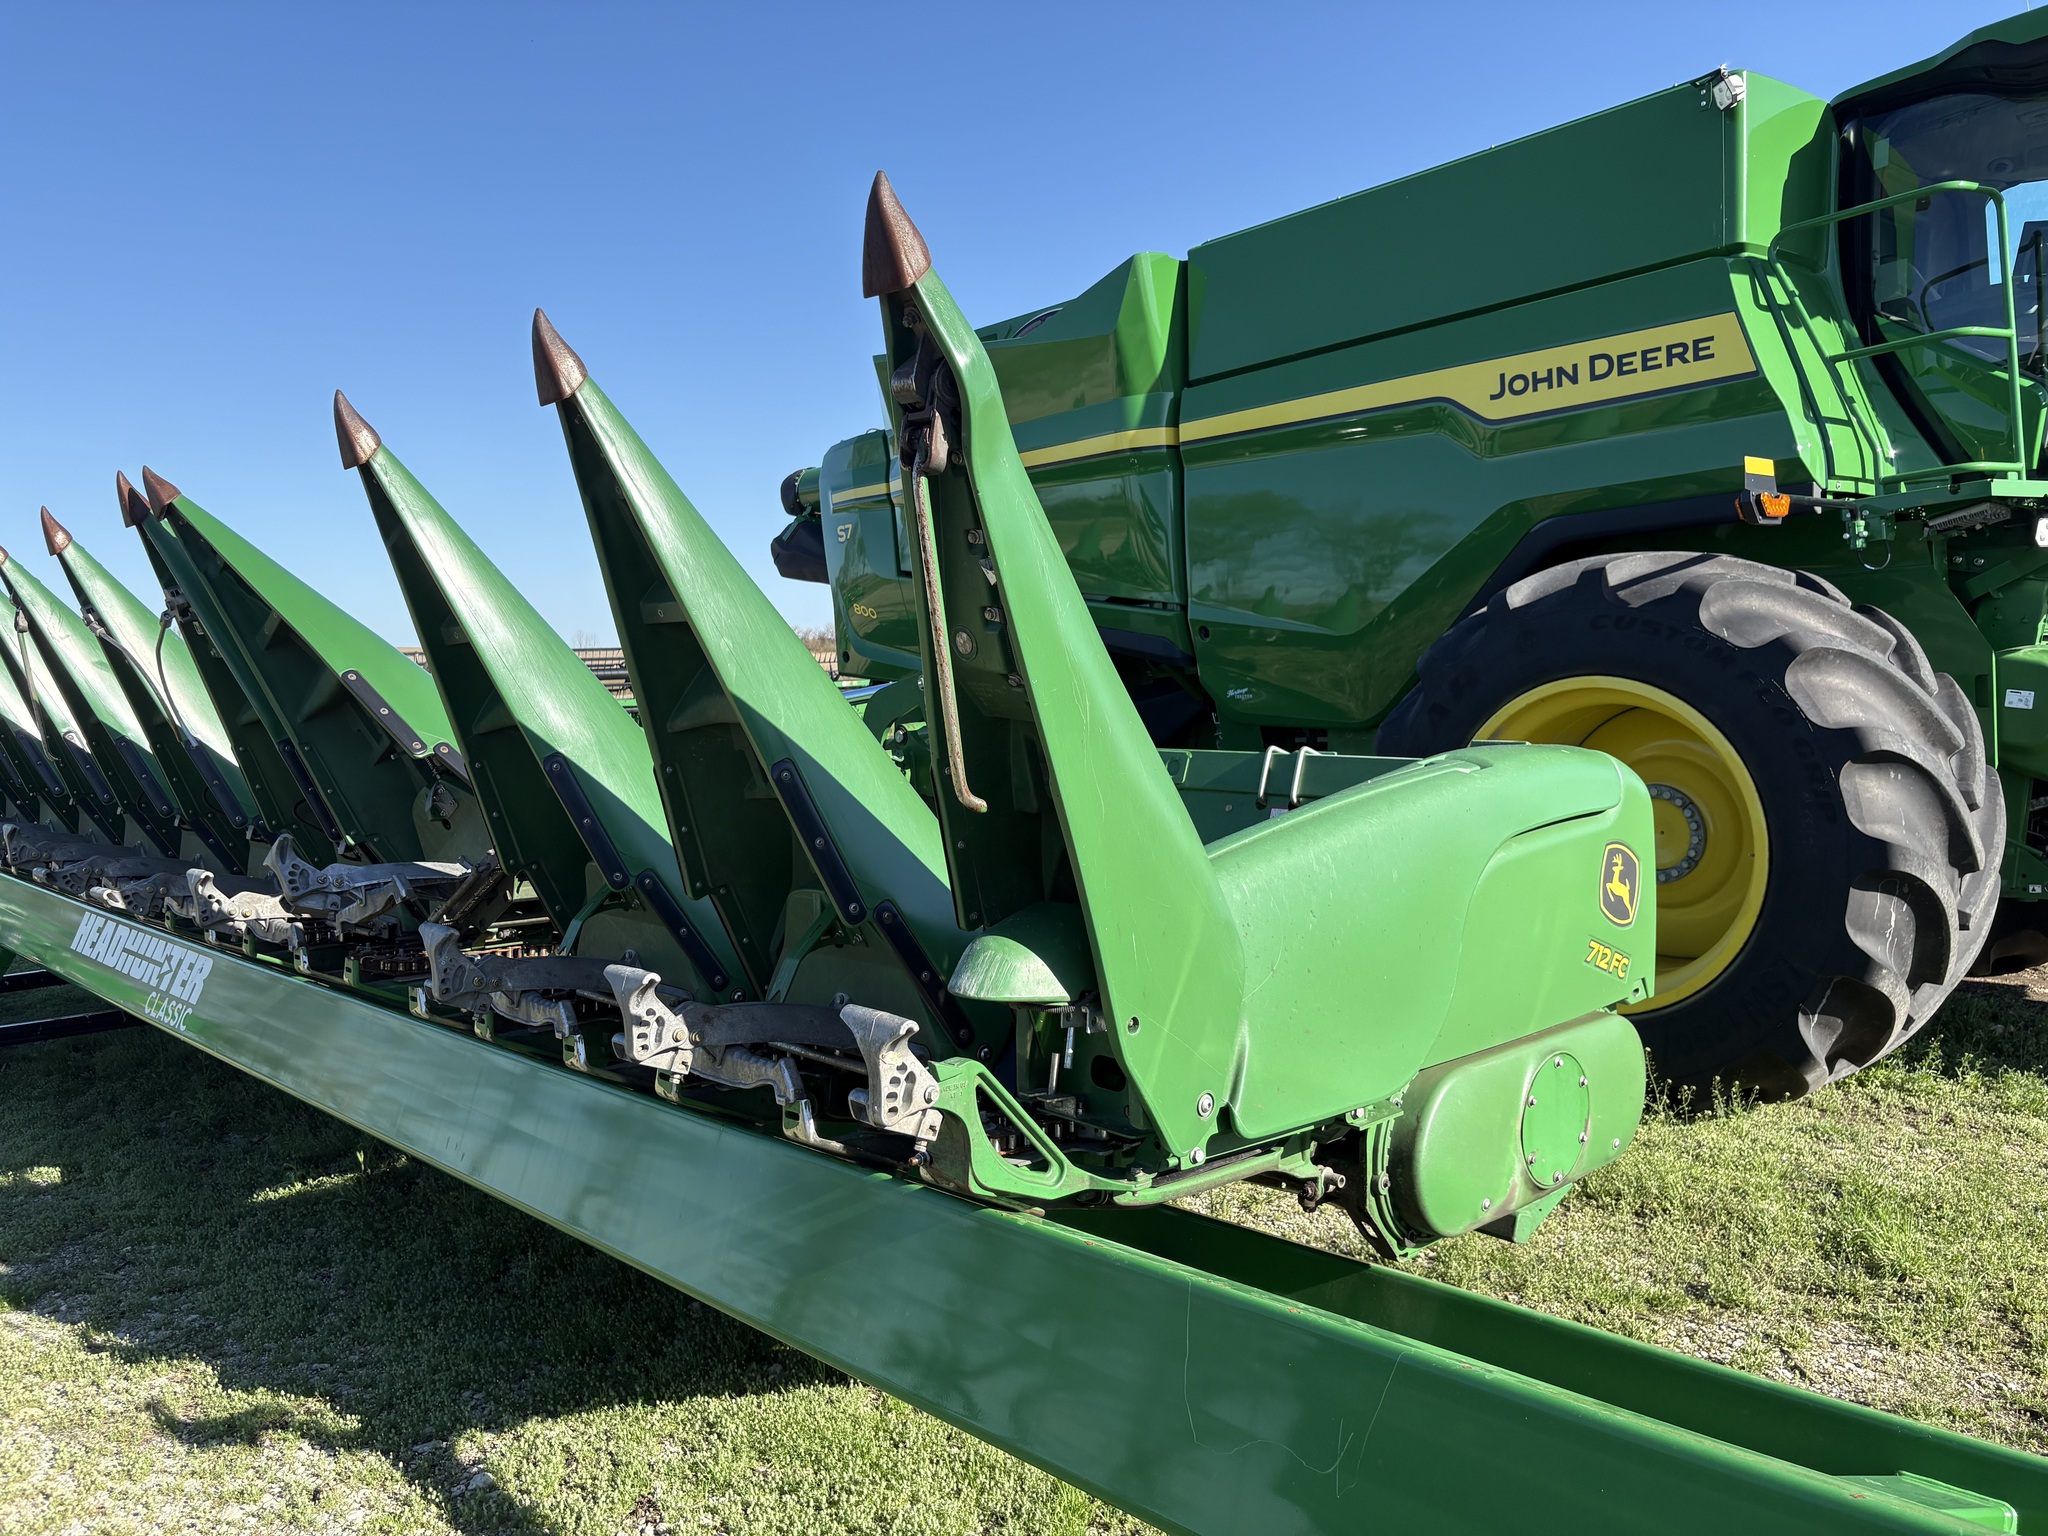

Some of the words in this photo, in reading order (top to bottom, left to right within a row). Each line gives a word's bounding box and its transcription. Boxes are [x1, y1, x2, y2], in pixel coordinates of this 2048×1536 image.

[1489, 363, 1579, 401] JOHN
[1589, 335, 1715, 382] DEERE
[836, 523, 853, 542] S7
[853, 603, 878, 619] 800
[1588, 613, 1738, 669] CUSTOM
[70, 911, 213, 1005] HEADHUNTER
[144, 991, 193, 1032] CLASSIC
